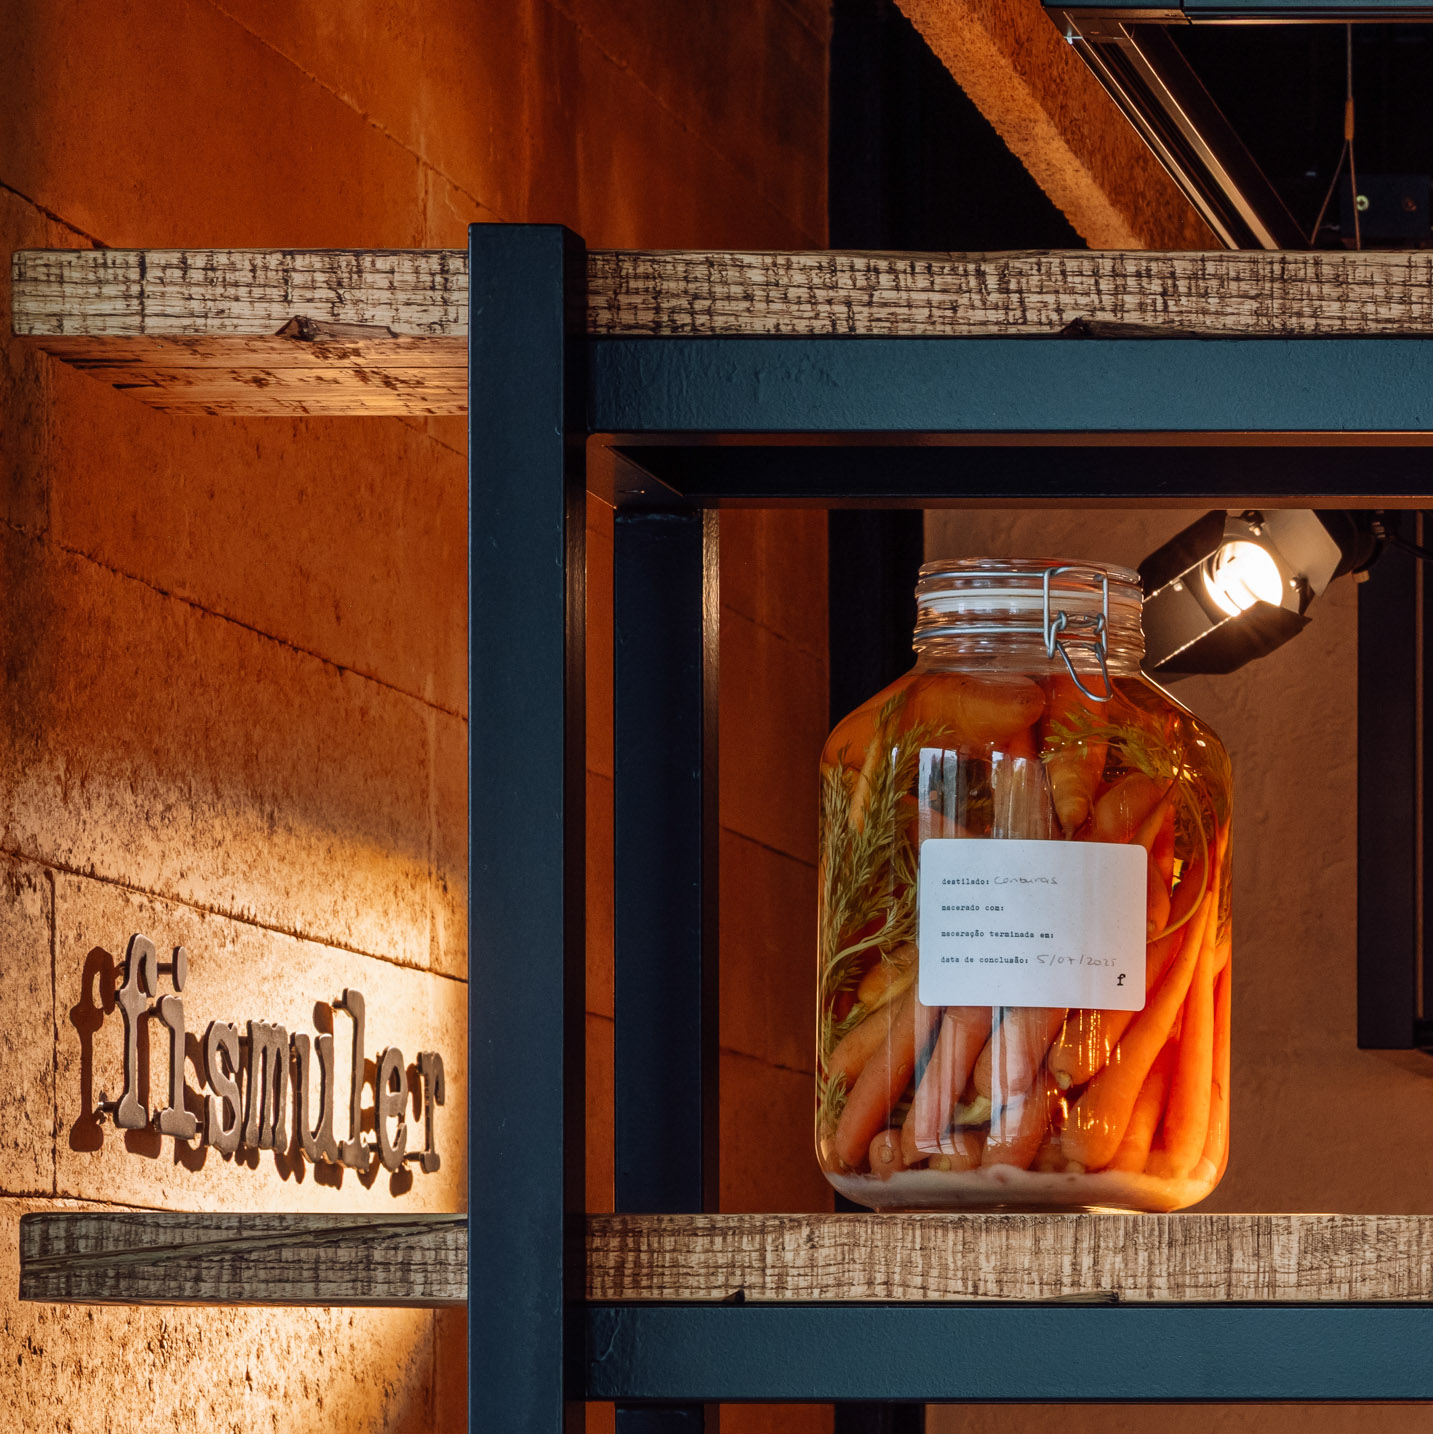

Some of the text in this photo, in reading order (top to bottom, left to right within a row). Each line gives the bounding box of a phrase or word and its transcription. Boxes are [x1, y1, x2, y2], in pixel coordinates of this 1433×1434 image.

[941, 877, 990, 886] destilado:
[941, 903, 981, 912] macerado
[940, 929, 985, 939] maceração
[988, 930, 1035, 939] terminada
[940, 955, 960, 964] data
[963, 955, 975, 964] de
[978, 955, 1029, 965] conclusão:
[1115, 972, 1127, 987] f
[114, 933, 445, 1174] fismuler
